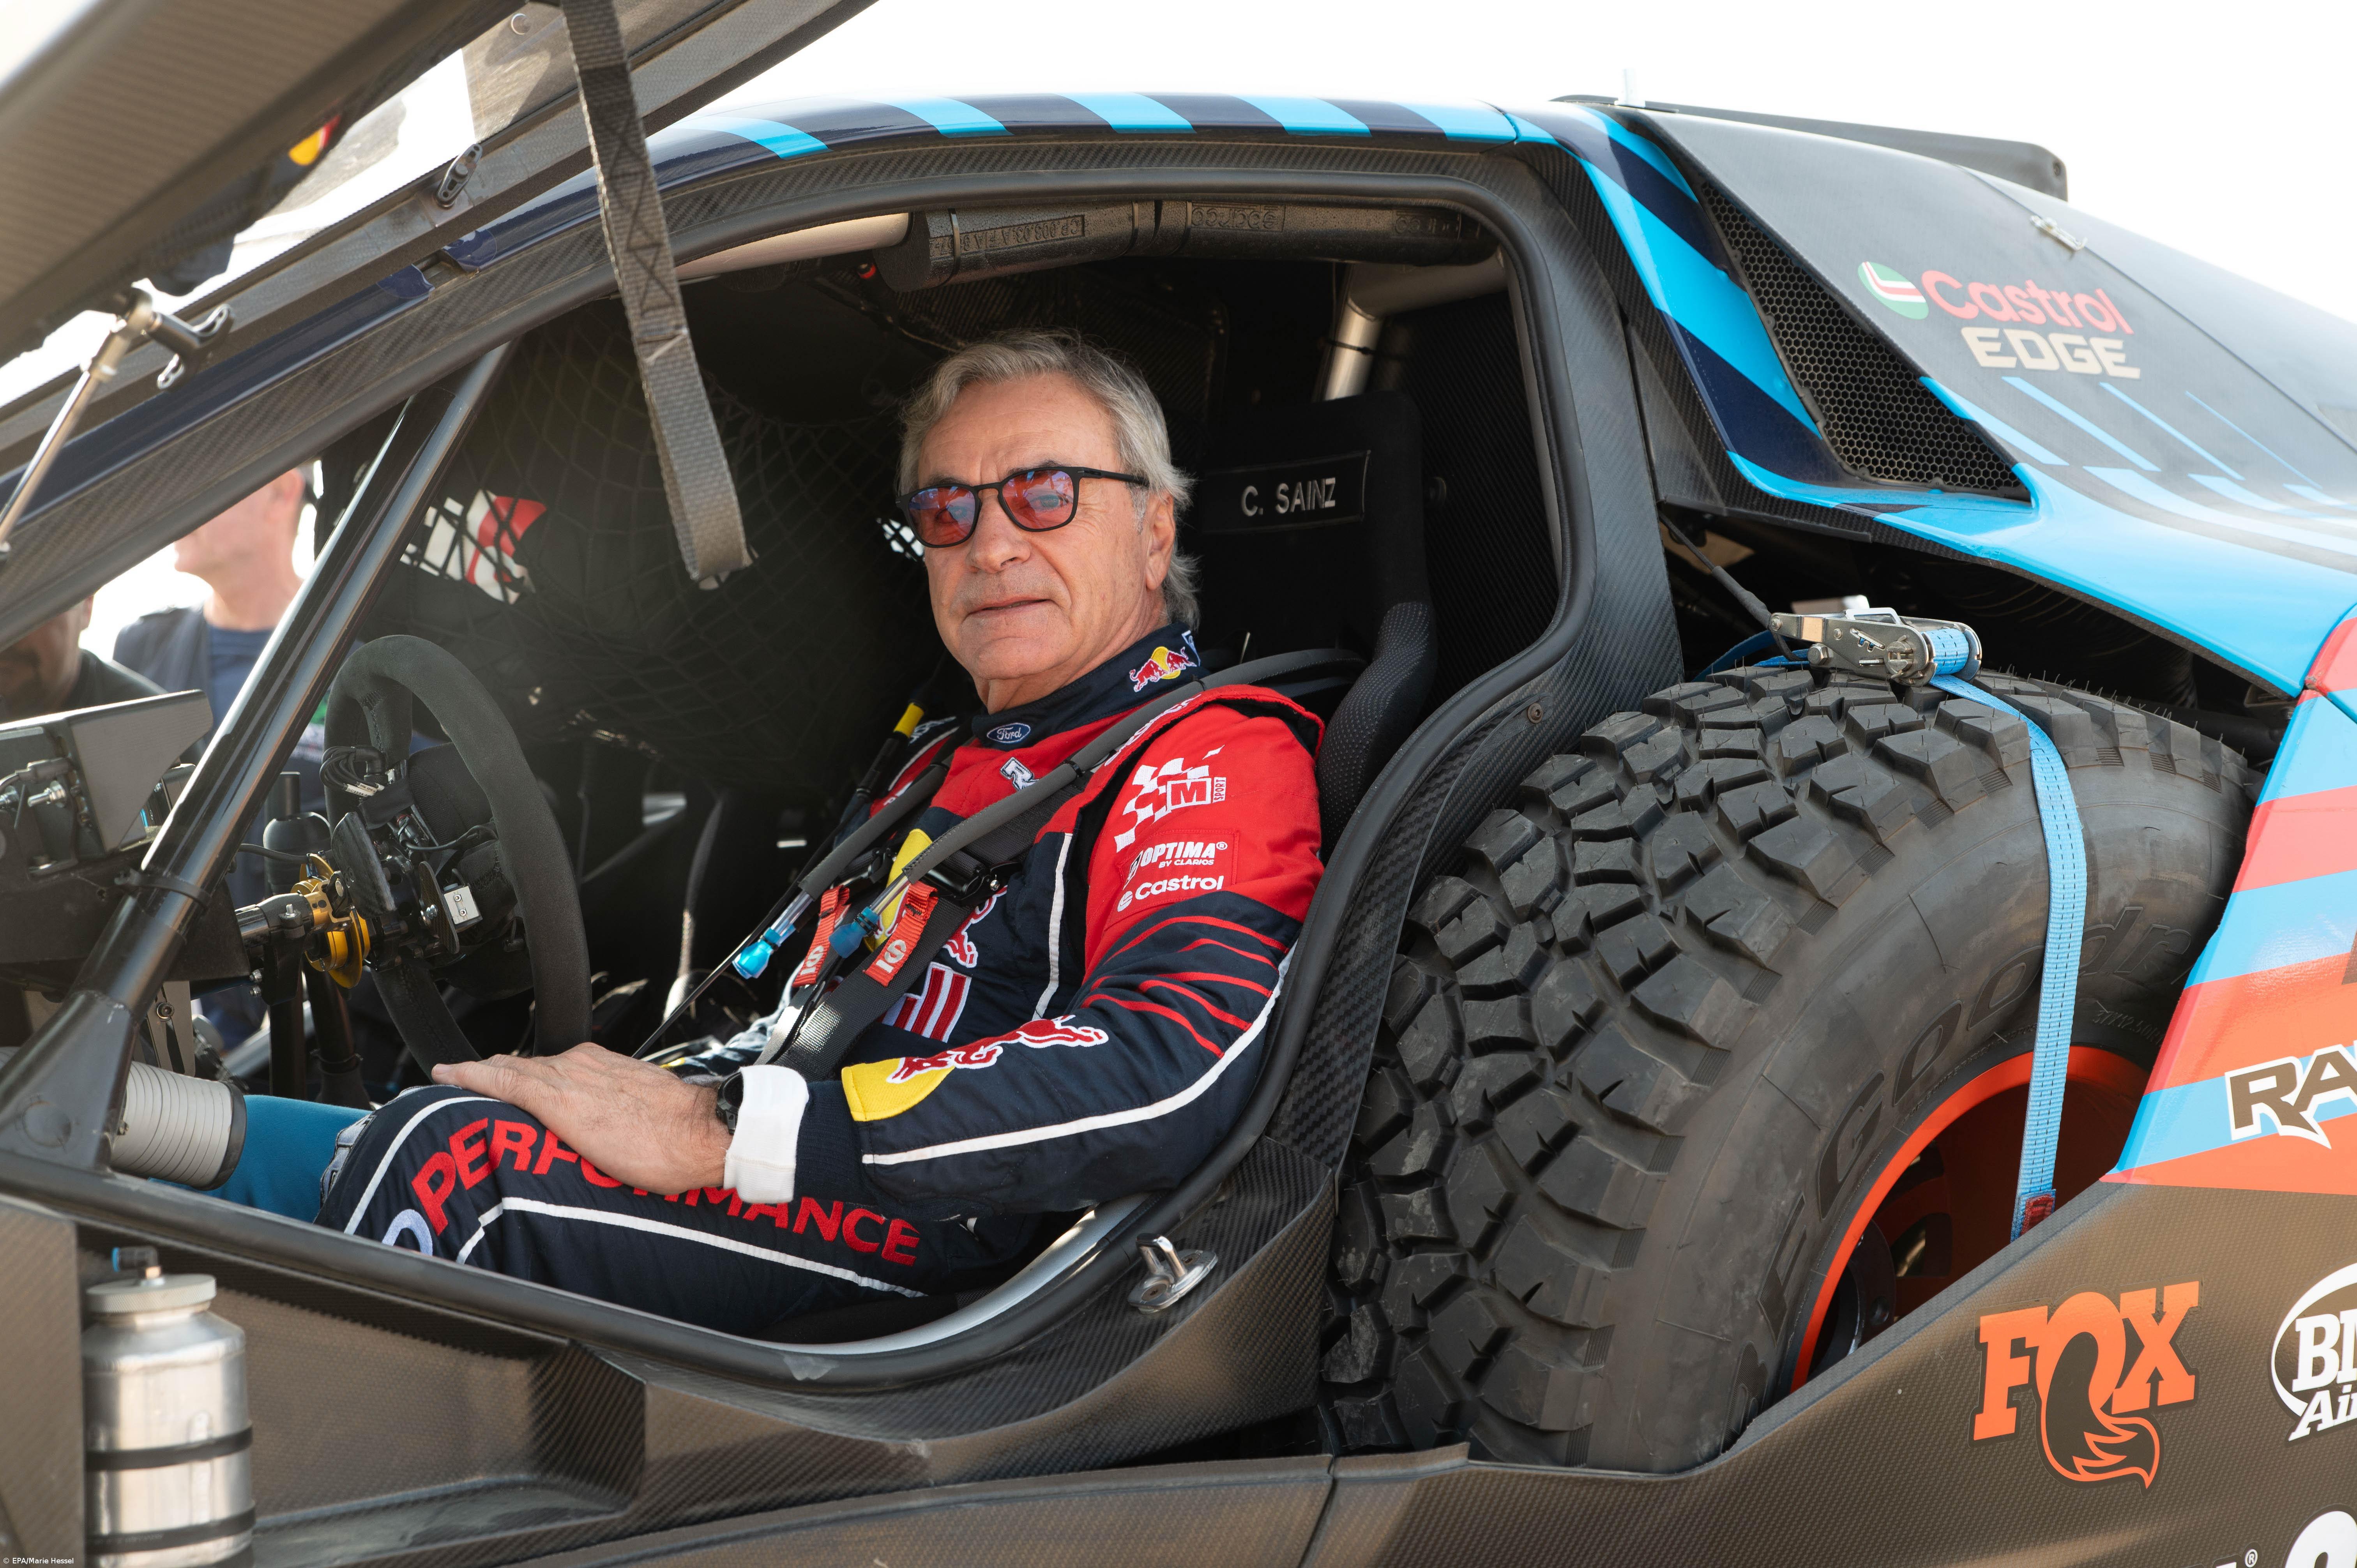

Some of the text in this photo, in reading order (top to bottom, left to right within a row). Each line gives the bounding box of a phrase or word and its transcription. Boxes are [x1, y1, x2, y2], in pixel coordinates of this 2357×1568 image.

[1921, 270, 2134, 335] Castrol
[1960, 326, 2141, 379] EDGE
[1241, 477, 1336, 517] C. SAINZ
[997, 727, 1022, 740] Ford
[1214, 779, 1226, 802] SPORT
[1158, 860, 1171, 869] BY
[2224, 1044, 2357, 1150] RA
[1974, 1280, 2200, 1489] FOX
[2288, 1384, 2357, 1441] Ai
